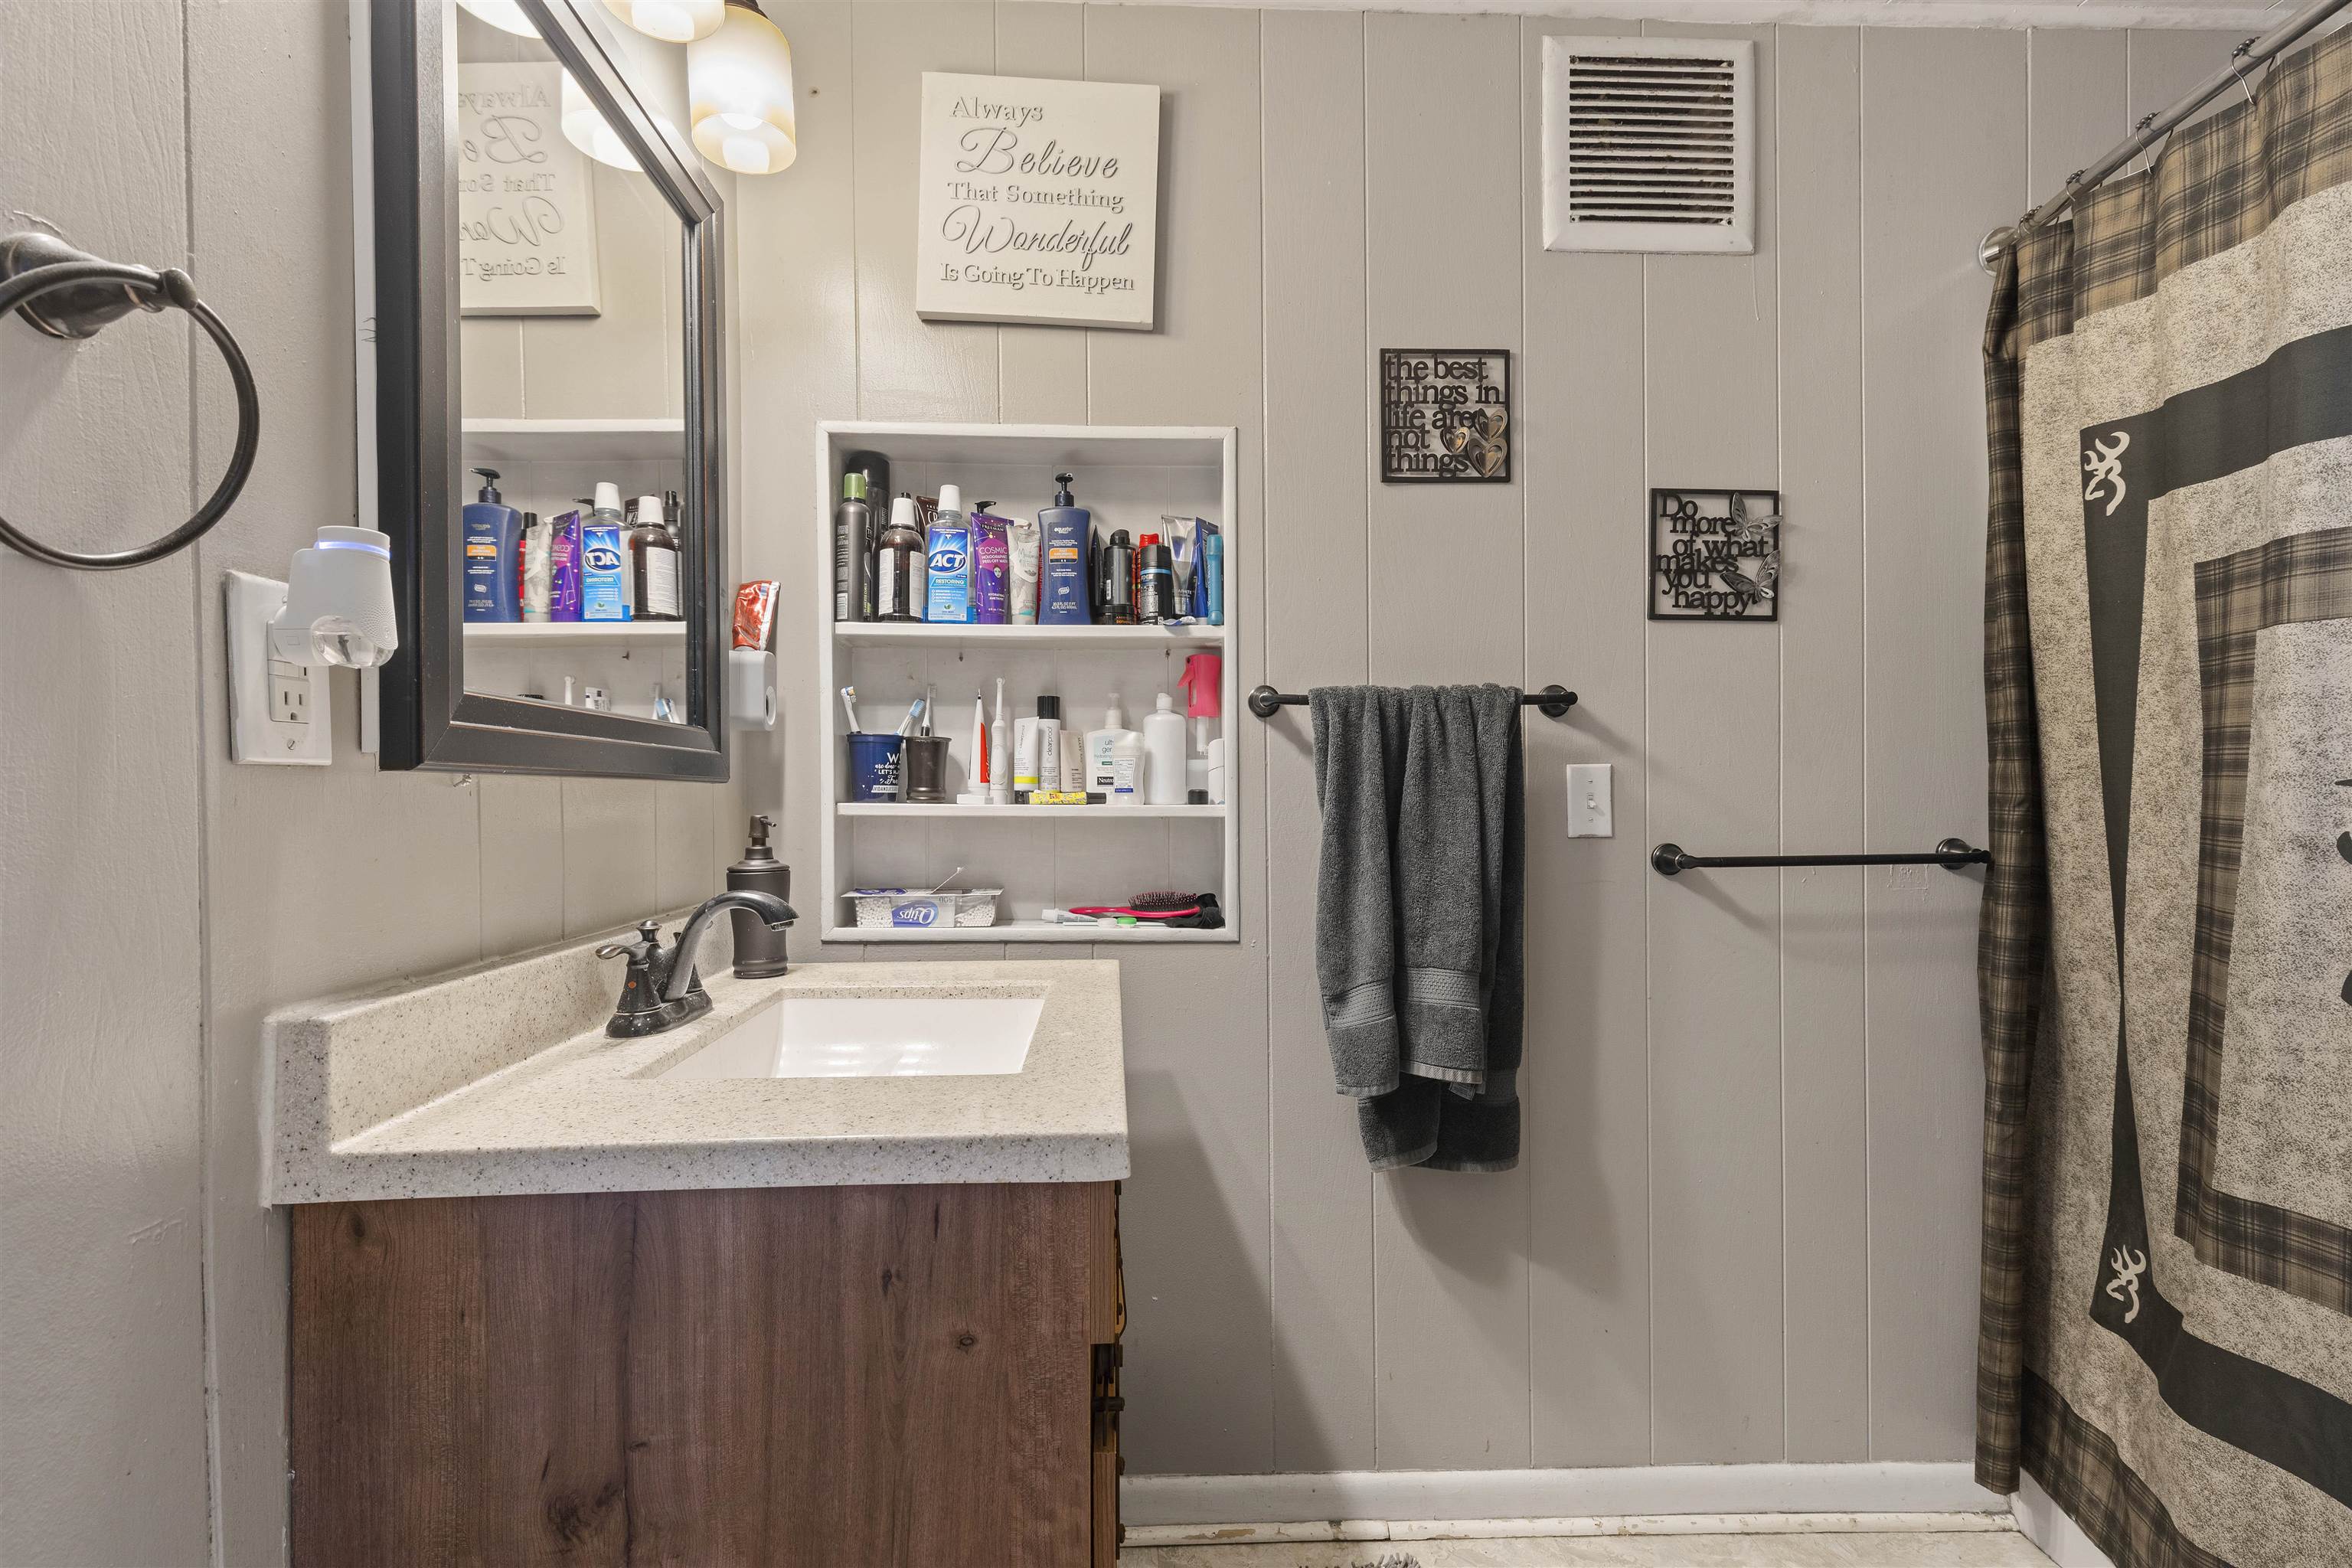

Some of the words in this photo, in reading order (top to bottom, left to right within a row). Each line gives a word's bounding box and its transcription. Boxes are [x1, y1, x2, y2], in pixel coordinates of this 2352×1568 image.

[950, 96, 1044, 127] Always
[956, 127, 1119, 178] Believe
[947, 182, 998, 202] That
[1007, 185, 1124, 214] Something
[942, 204, 1133, 270] Wonderful
[940, 263, 959, 282] Is
[964, 265, 1024, 289] Going
[1027, 268, 1053, 286] To
[1056, 269, 1134, 294] Happen
[1385, 354, 1429, 381] the
[1434, 354, 1488, 382] best
[1385, 382, 1468, 411] things
[1475, 383, 1505, 403] in
[1385, 402, 1426, 429] life
[1432, 409, 1476, 430] are
[1386, 423, 1430, 449] not
[1387, 447, 1469, 478] things
[1660, 494, 1698, 518] Do
[982, 524, 1004, 532] FREEMAN
[1670, 516, 1736, 536] more
[1673, 534, 1696, 556] of
[1702, 536, 1769, 557] what
[930, 554, 963, 567] ACT
[1655, 549, 1739, 573] makes
[1662, 570, 1711, 594] you
[1672, 586, 1758, 616] happy
[897, 907, 934, 924] Q-tips
